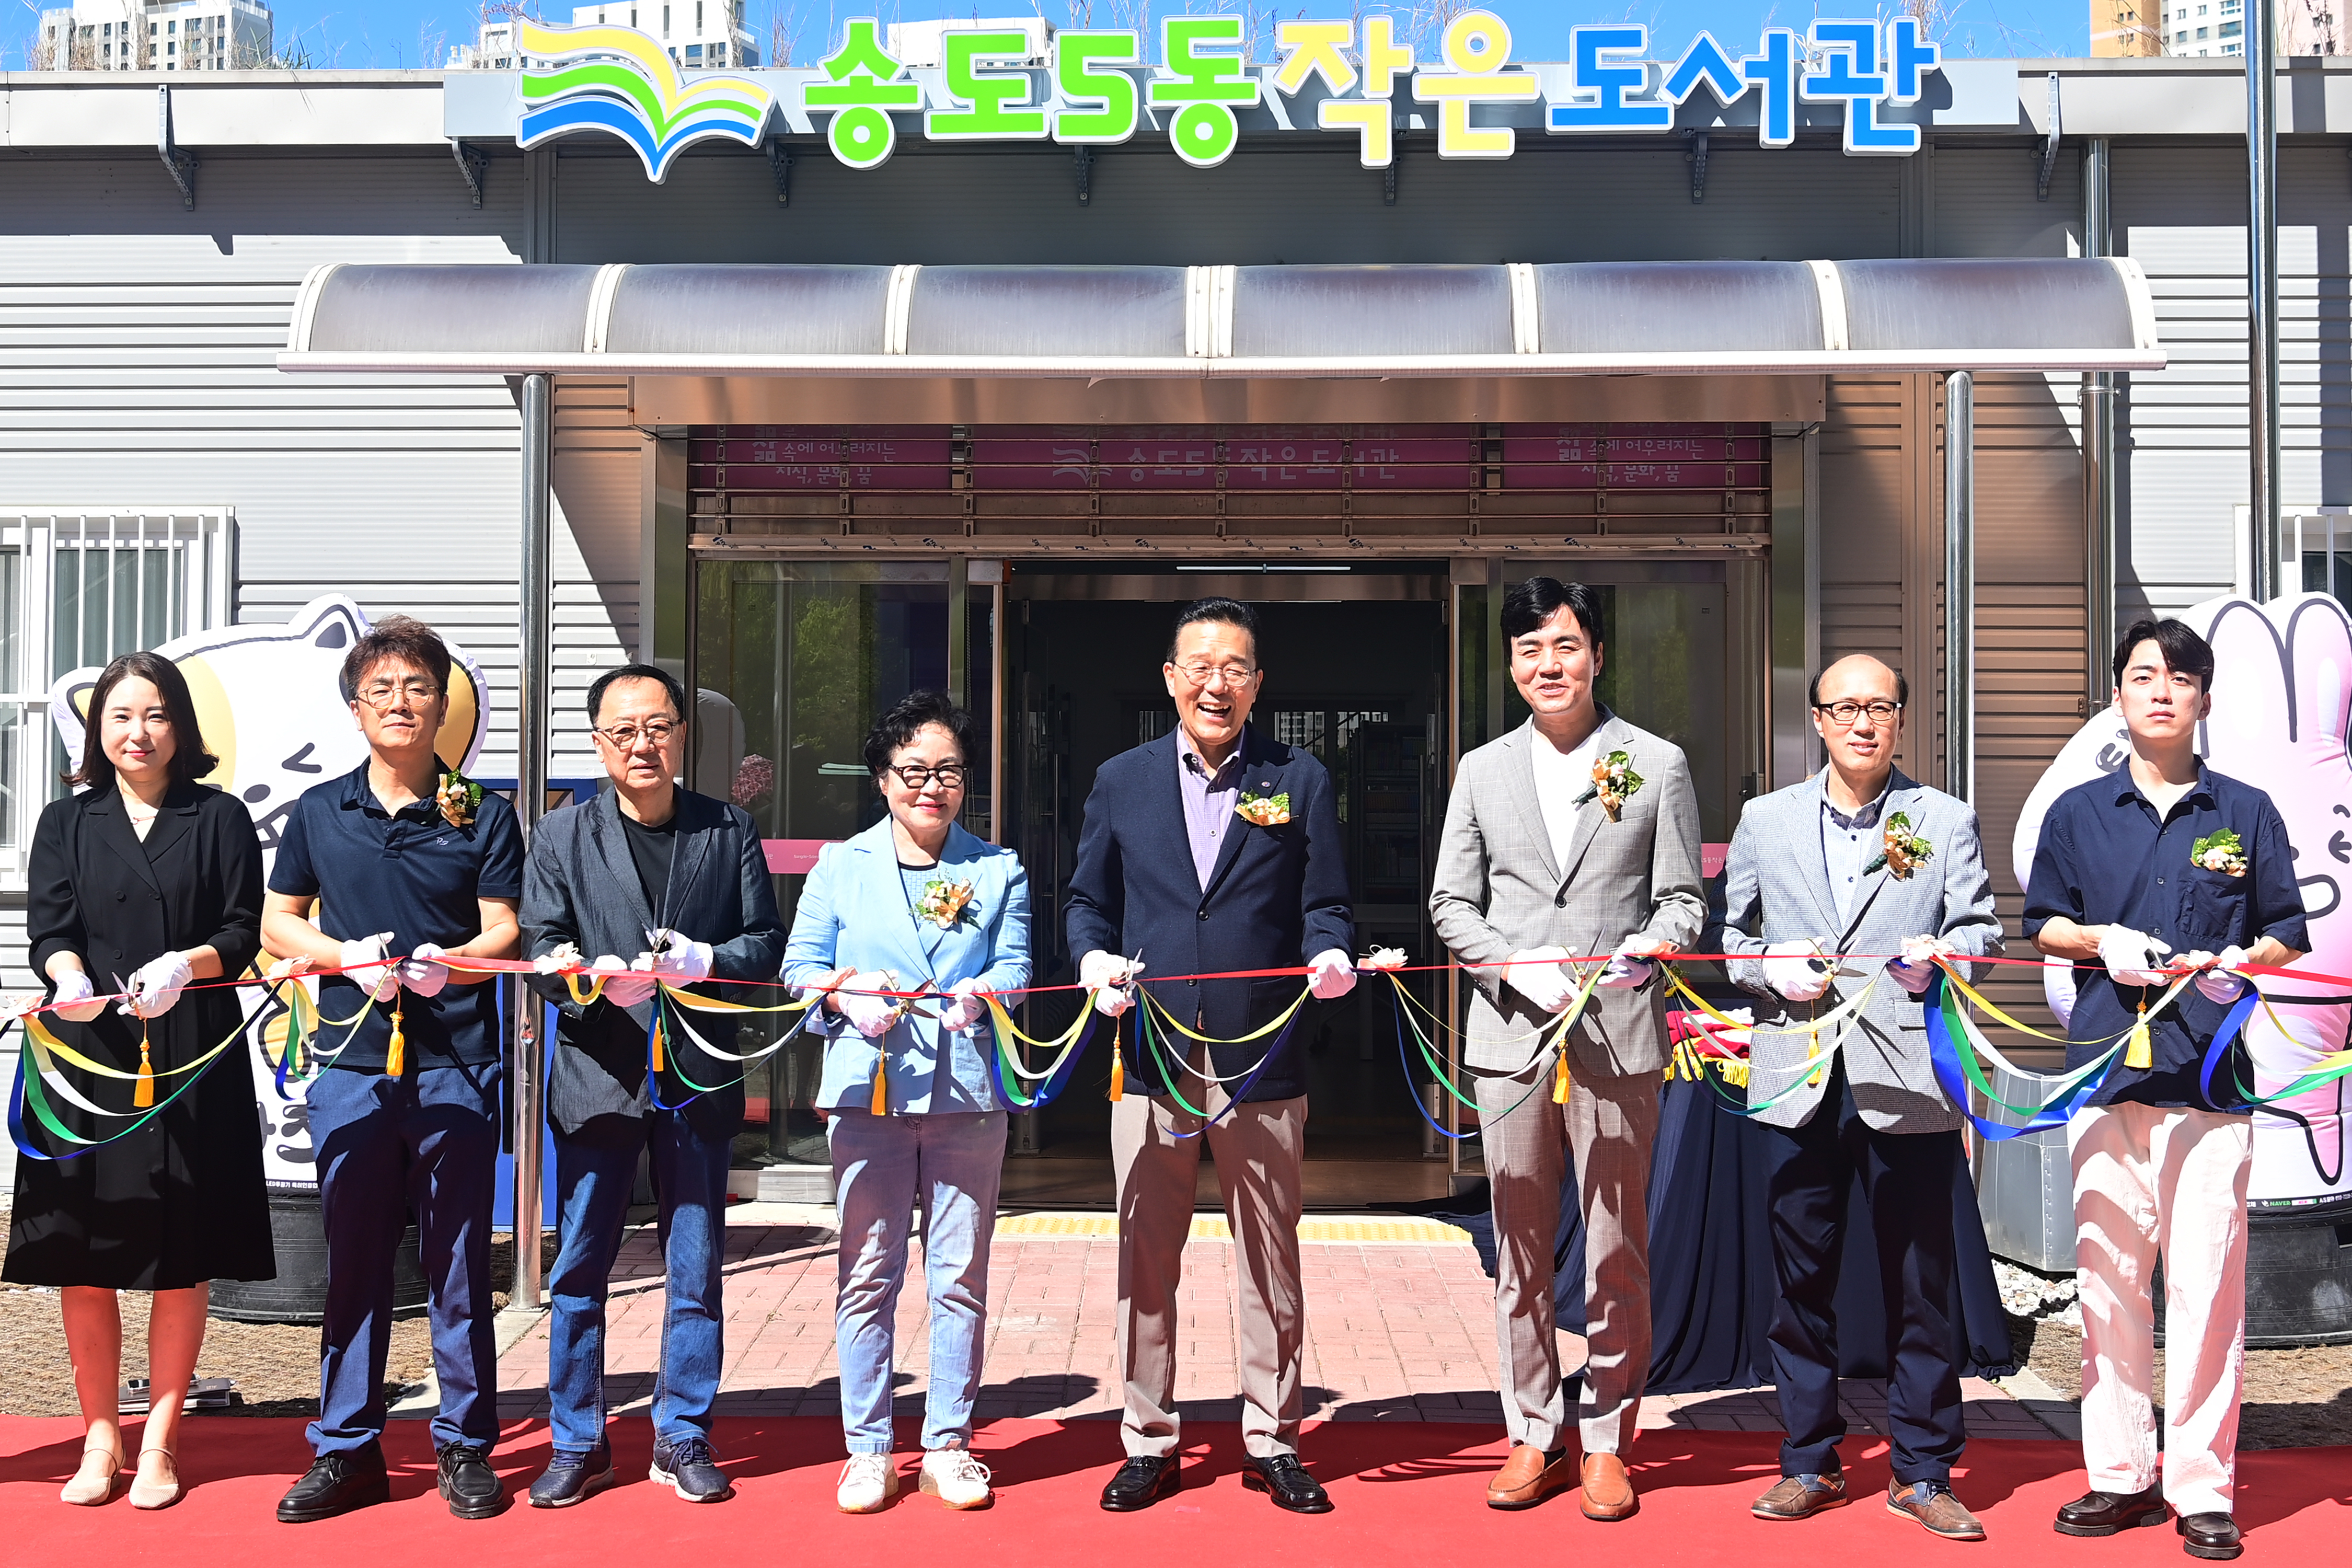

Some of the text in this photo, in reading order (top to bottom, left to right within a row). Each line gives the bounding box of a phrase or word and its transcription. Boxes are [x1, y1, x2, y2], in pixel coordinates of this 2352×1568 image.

[803, 13, 1937, 164] 송도5동 작은 도서관
[782, 442, 813, 462] 속에
[1625, 440, 1704, 460] 어우러지는
[1239, 446, 1297, 481] 작은
[1665, 465, 1680, 482] 꿈
[857, 466, 872, 485] 꿈
